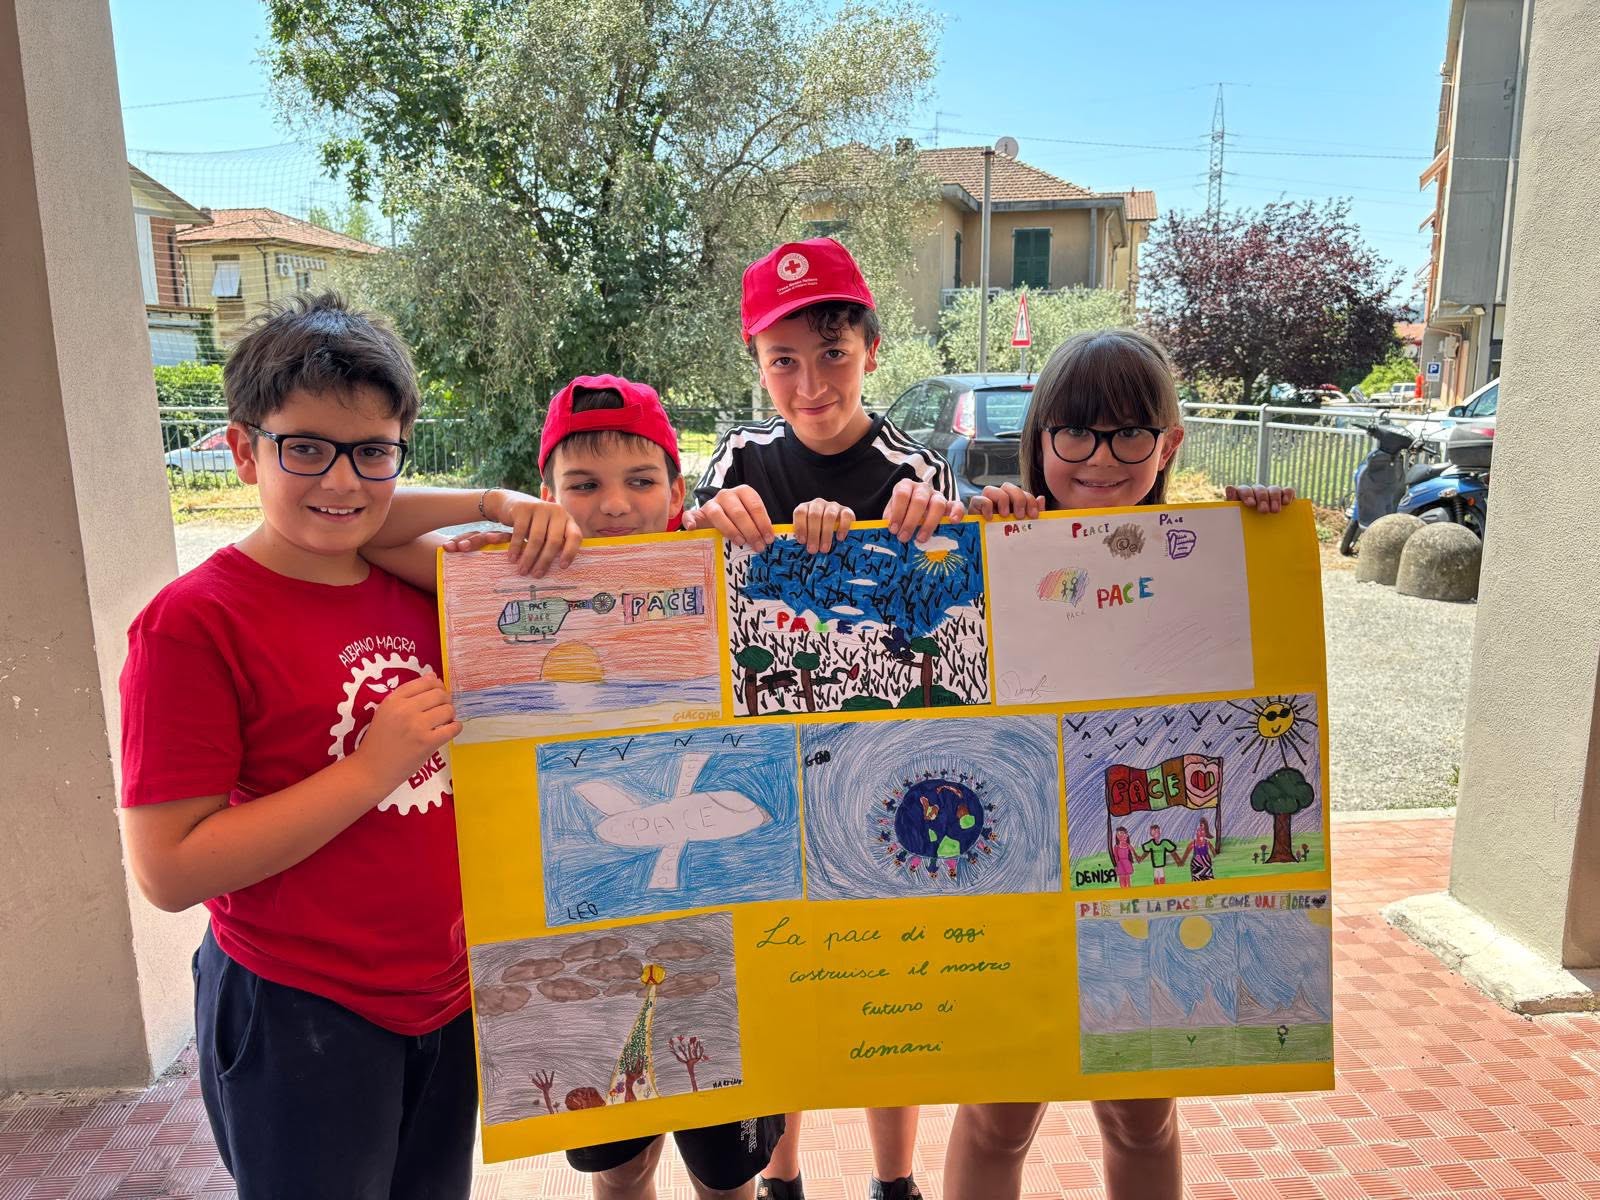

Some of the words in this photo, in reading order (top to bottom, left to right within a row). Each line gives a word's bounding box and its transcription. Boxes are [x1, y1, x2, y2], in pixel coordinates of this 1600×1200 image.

[1004, 523, 1033, 537] PACE
[631, 592, 697, 616] PACE
[1096, 576, 1154, 609] PACE
[528, 601, 548, 611] PACE
[338, 636, 375, 669] ALBIANO
[375, 635, 416, 654] MAGRA
[672, 710, 721, 722] GIACOMO
[408, 750, 447, 790] BIKE
[1111, 773, 1181, 805] PACE
[631, 804, 717, 841] PACE
[567, 900, 599, 921] LEO
[1120, 899, 1140, 914] ME
[1147, 900, 1162, 913] LA
[1221, 895, 1250, 909] COME
[756, 916, 807, 949] La
[823, 929, 882, 951] pace
[901, 925, 926, 942] di
[943, 924, 986, 944] oggi
[789, 968, 891, 983] costruisce
[908, 960, 930, 976] il
[940, 961, 1011, 974] nostro
[937, 999, 957, 1013] di
[849, 1040, 944, 1060] domani
